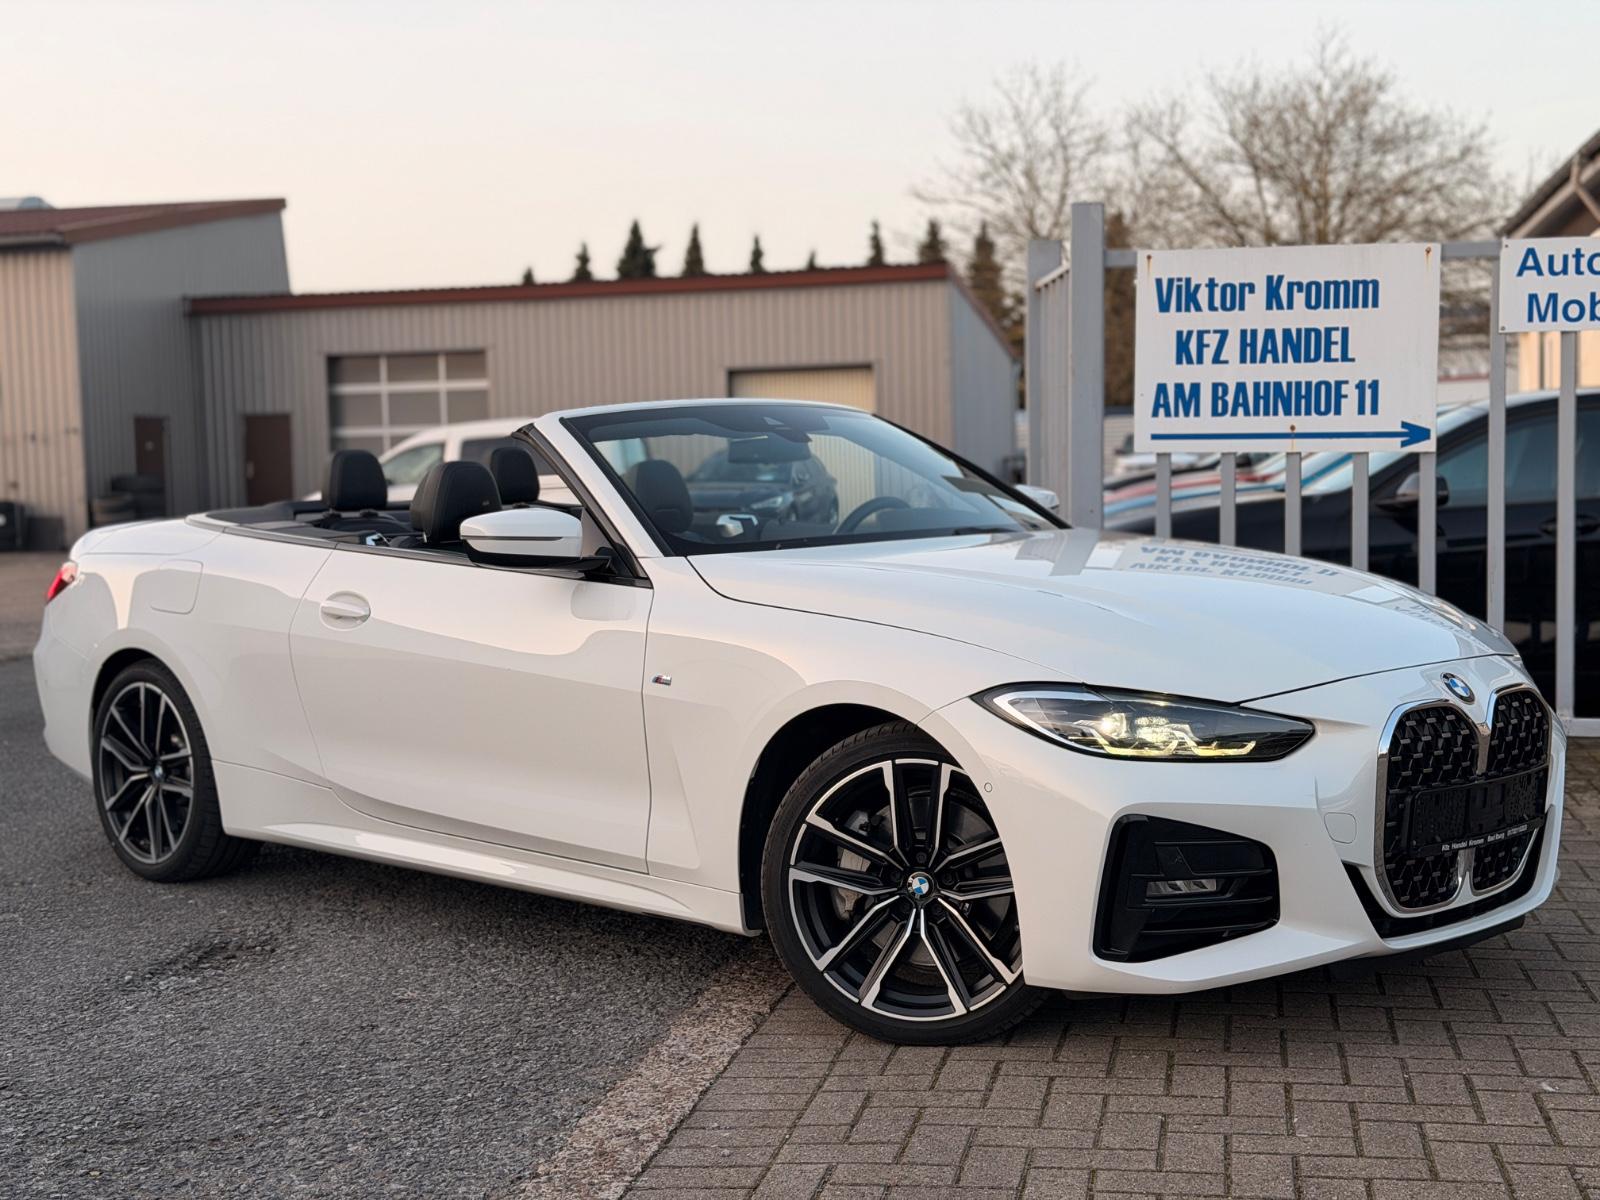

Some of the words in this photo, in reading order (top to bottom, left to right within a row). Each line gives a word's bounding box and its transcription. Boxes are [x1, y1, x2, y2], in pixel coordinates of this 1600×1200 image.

[1155, 276, 1256, 313] Viktor
[1265, 274, 1380, 311] Kromm
[1175, 329, 1230, 366] KFZ
[1239, 326, 1356, 365] HANDEL
[1151, 382, 1201, 418] AM
[1211, 380, 1349, 418] BAHNHOF
[1355, 379, 1380, 416] 11
